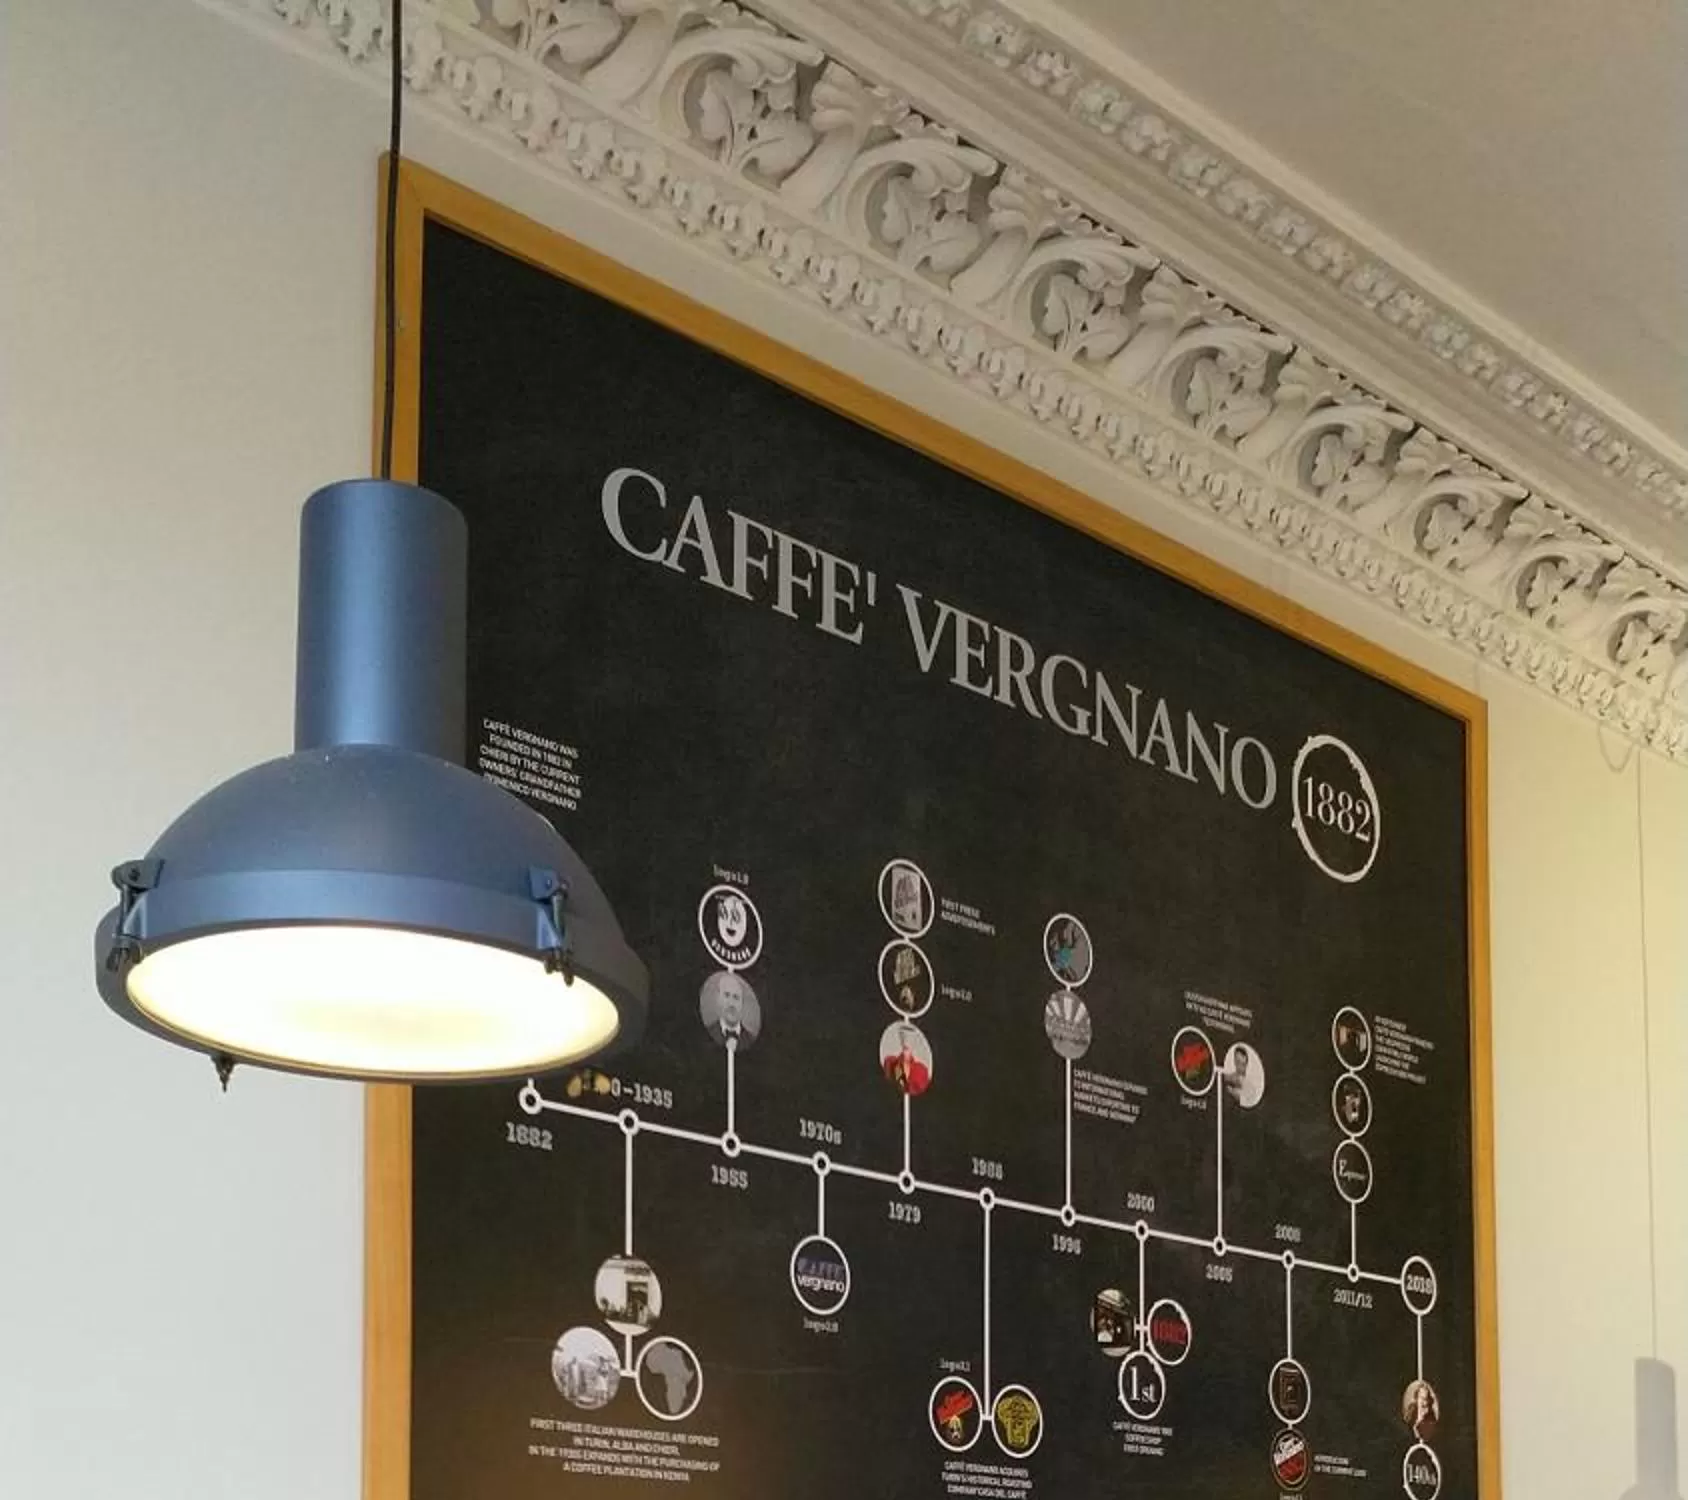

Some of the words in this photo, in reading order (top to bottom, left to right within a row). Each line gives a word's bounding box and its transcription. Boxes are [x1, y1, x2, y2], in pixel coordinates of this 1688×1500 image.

[600, 467, 877, 645] CAFFE'
[896, 583, 1277, 809] VERGNANO
[1303, 776, 1371, 843] 1882
[505, 1121, 553, 1150] 1882
